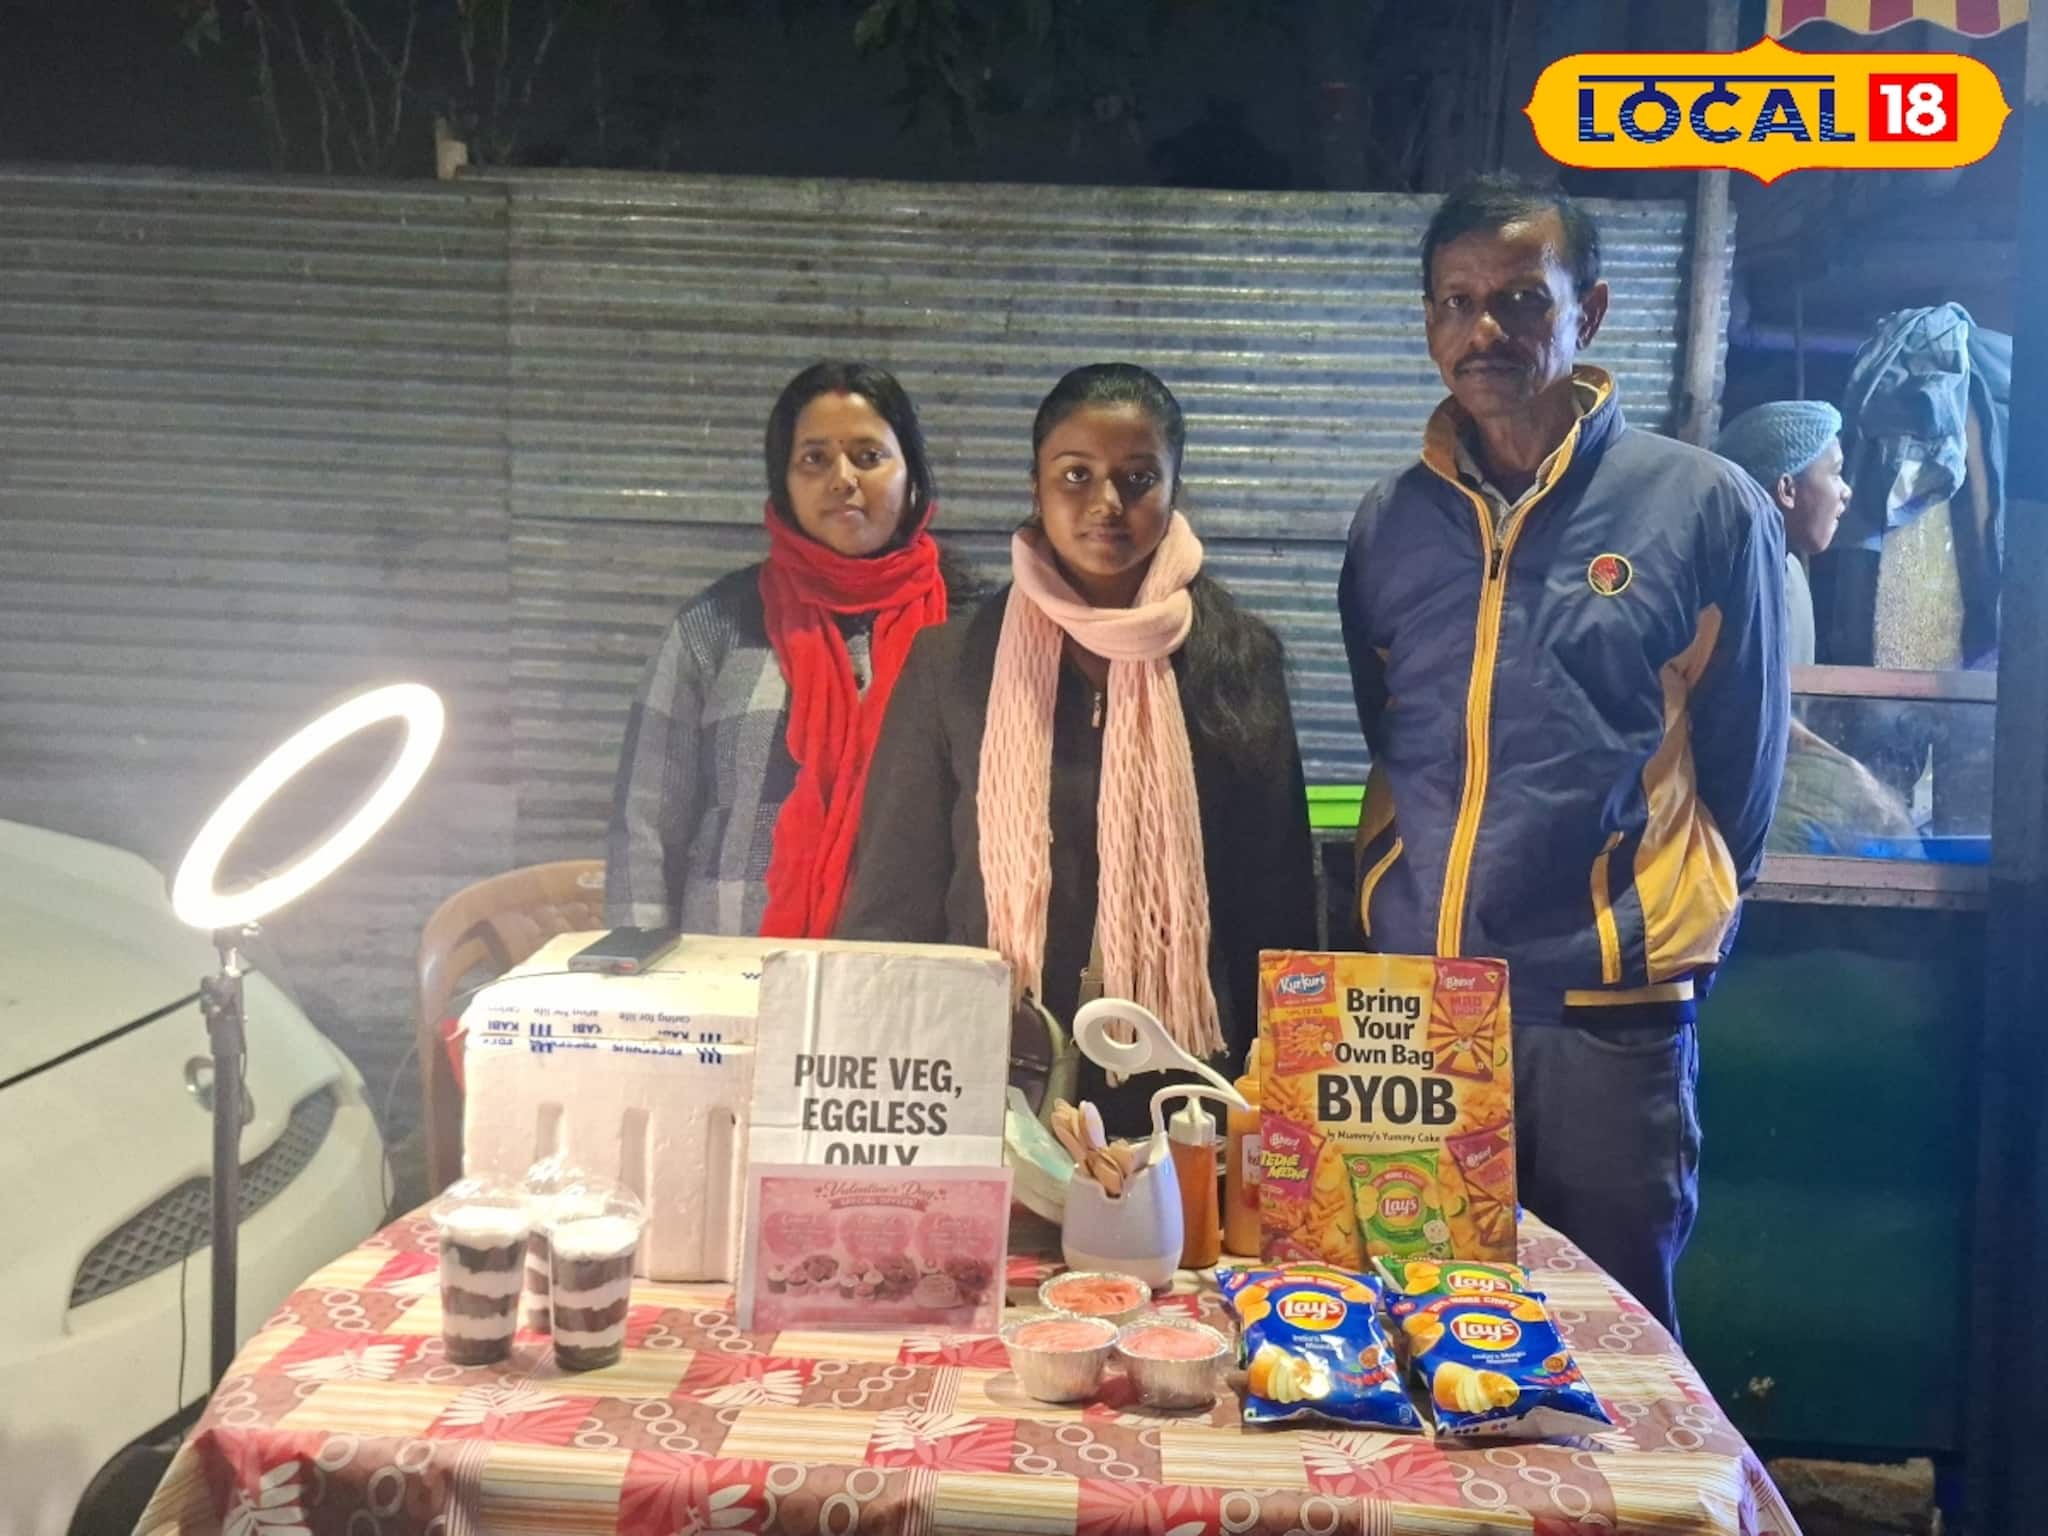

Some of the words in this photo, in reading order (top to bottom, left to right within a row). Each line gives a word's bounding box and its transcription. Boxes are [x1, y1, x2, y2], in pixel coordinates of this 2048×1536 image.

[1346, 988, 1420, 1019] Bring
[1353, 1016, 1415, 1040] Your
[1334, 1043, 1386, 1064] Own
[1392, 1044, 1434, 1070] Bag
[794, 1054, 877, 1089] PURE
[889, 1057, 962, 1098] VEG,
[1318, 1074, 1457, 1126] BYOB
[802, 1098, 948, 1136] EGGLESS
[1338, 1131, 1380, 1142] Mummy's
[1382, 1132, 1416, 1143] Yummy
[1417, 1133, 1441, 1142] Cake
